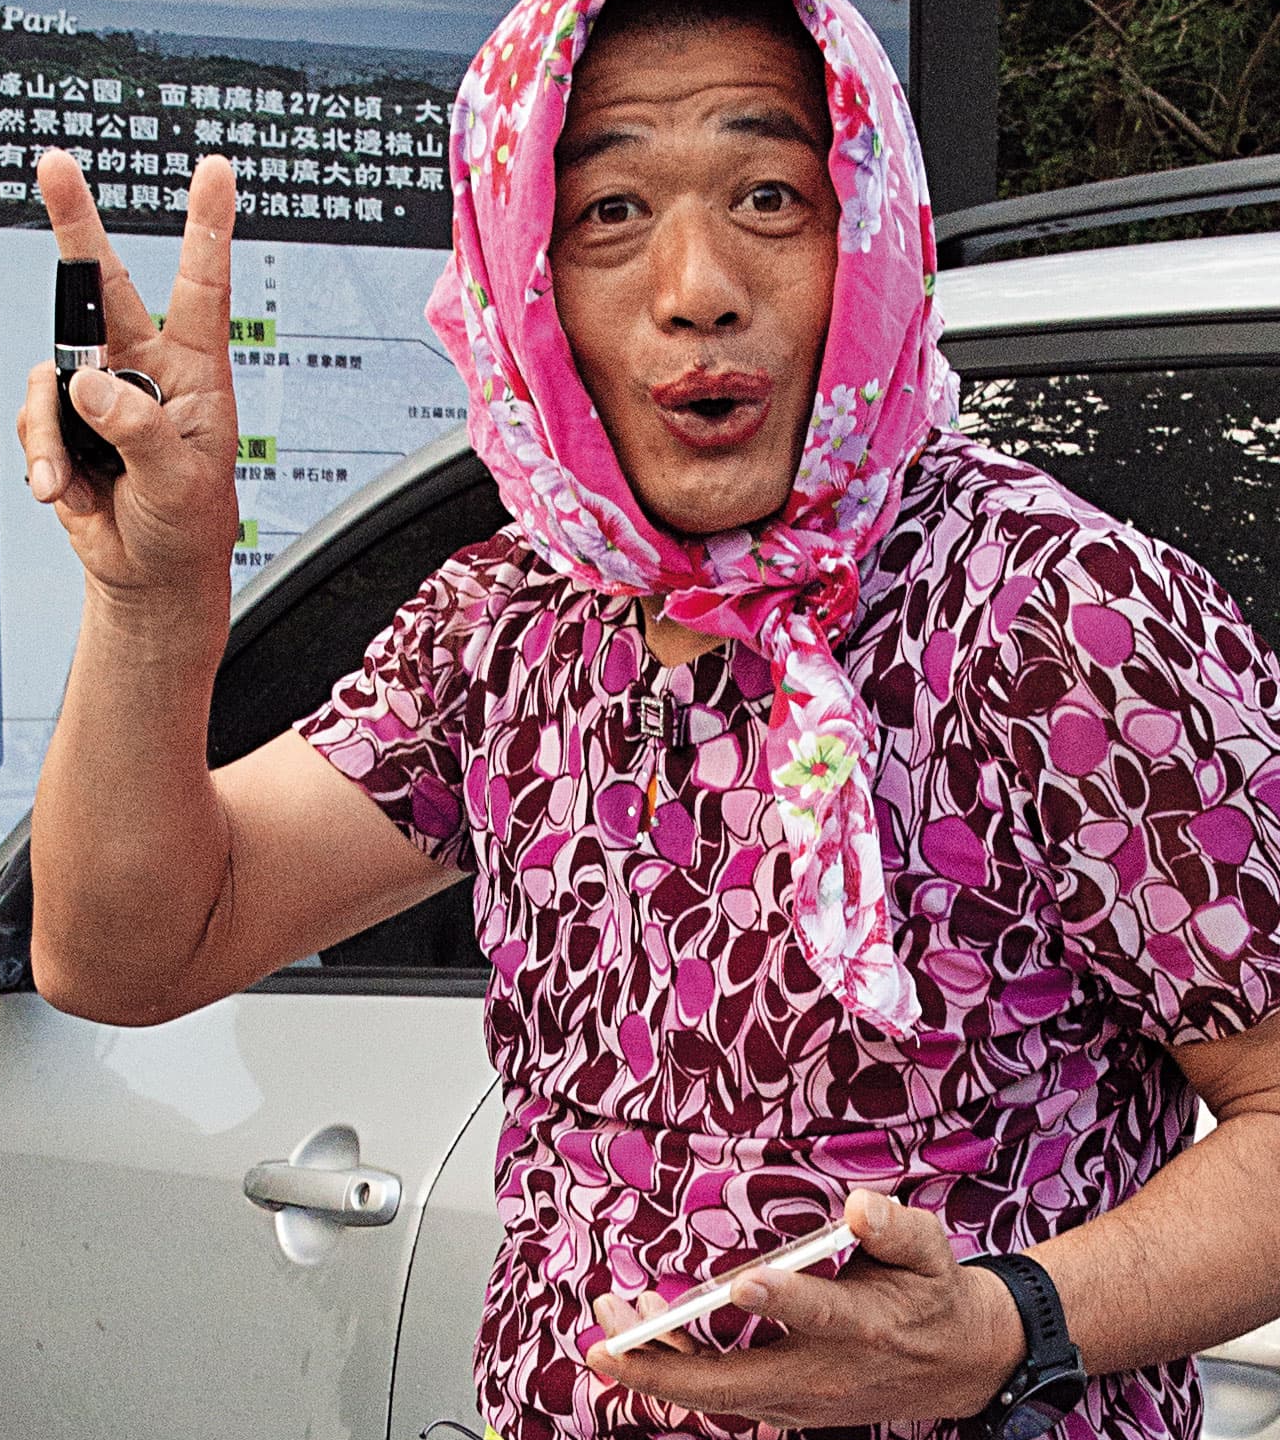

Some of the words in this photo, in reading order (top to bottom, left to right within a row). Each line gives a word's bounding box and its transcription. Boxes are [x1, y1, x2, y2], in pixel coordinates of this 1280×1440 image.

[2, 7, 77, 36] Park
[265, 254, 276, 313] 中山路
